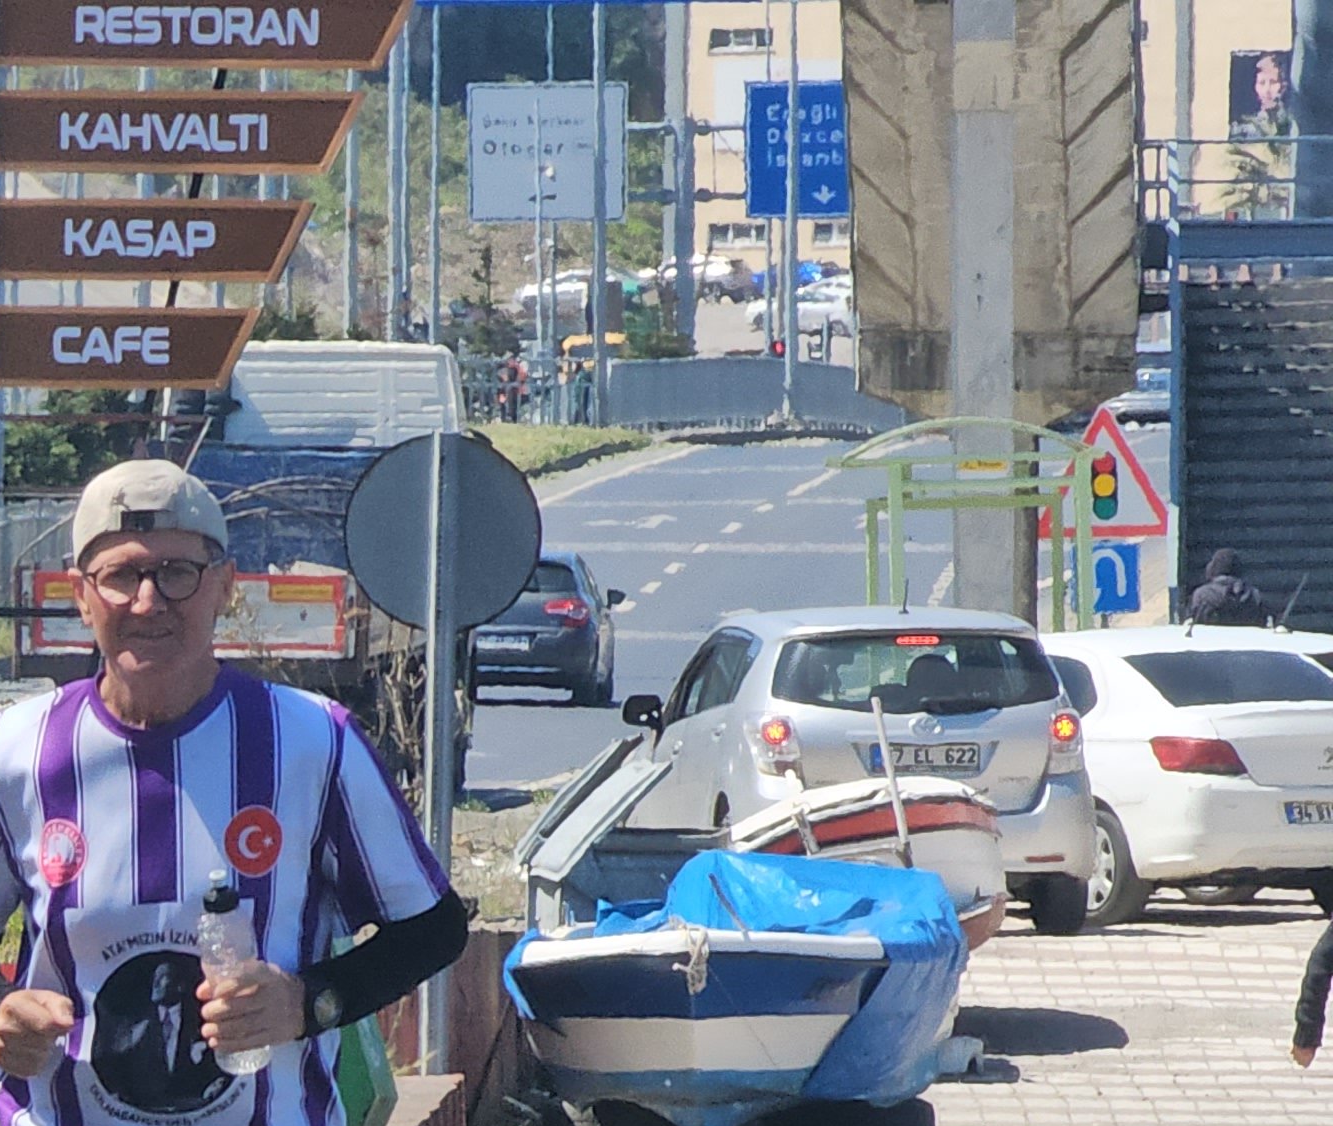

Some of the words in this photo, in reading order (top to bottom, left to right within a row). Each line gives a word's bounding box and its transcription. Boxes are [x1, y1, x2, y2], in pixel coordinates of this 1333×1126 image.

[74, 5, 320, 47] RESTORAN
[59, 111, 269, 152] KAHVALTI
[63, 217, 217, 258] KASAP
[52, 325, 171, 365] CAFE
[913, 748, 935, 764] EL
[945, 747, 977, 764] 622
[169, 928, 199, 947] İZİN
